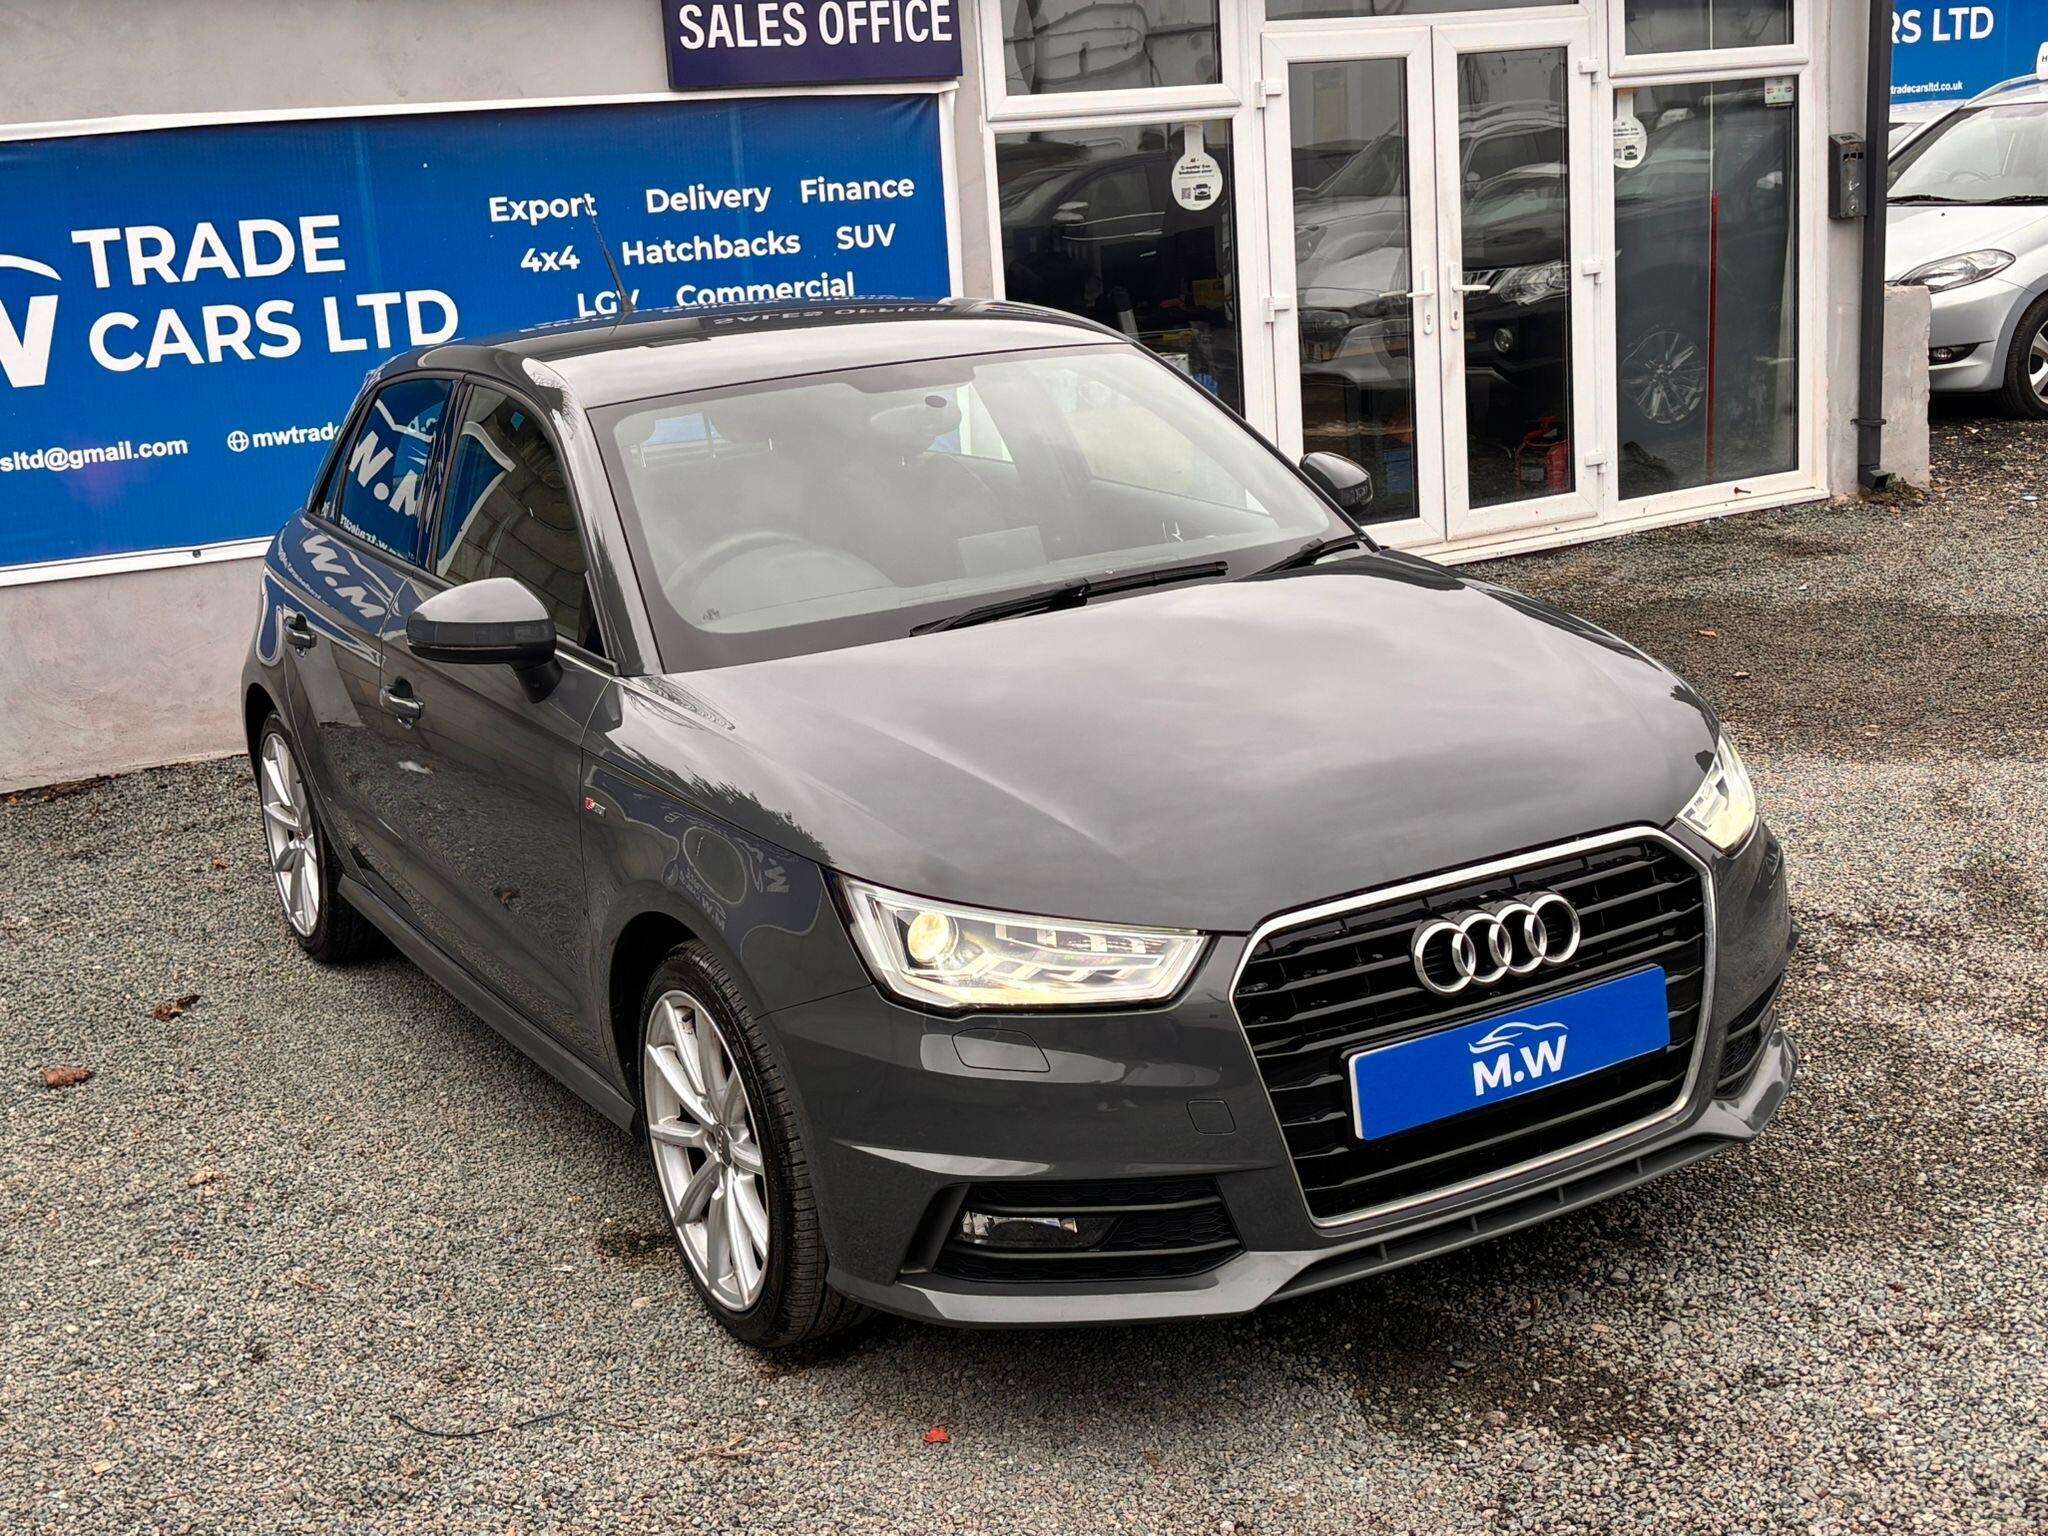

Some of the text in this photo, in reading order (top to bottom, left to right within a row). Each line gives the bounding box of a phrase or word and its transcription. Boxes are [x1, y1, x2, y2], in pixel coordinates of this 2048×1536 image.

[679, 0, 953, 50] SALES OFFICE
[1932, 6, 1994, 42] LTD
[489, 175, 915, 226] Export Delivery Finance
[70, 214, 346, 289] TRADE
[520, 222, 896, 273] 4x4 Hatchbacks SUV
[676, 271, 855, 307] Commercial
[89, 289, 460, 372] CARS LTD
[0, 439, 189, 472] sltd@gmail.com
[1472, 1034, 1568, 1097] M.W
